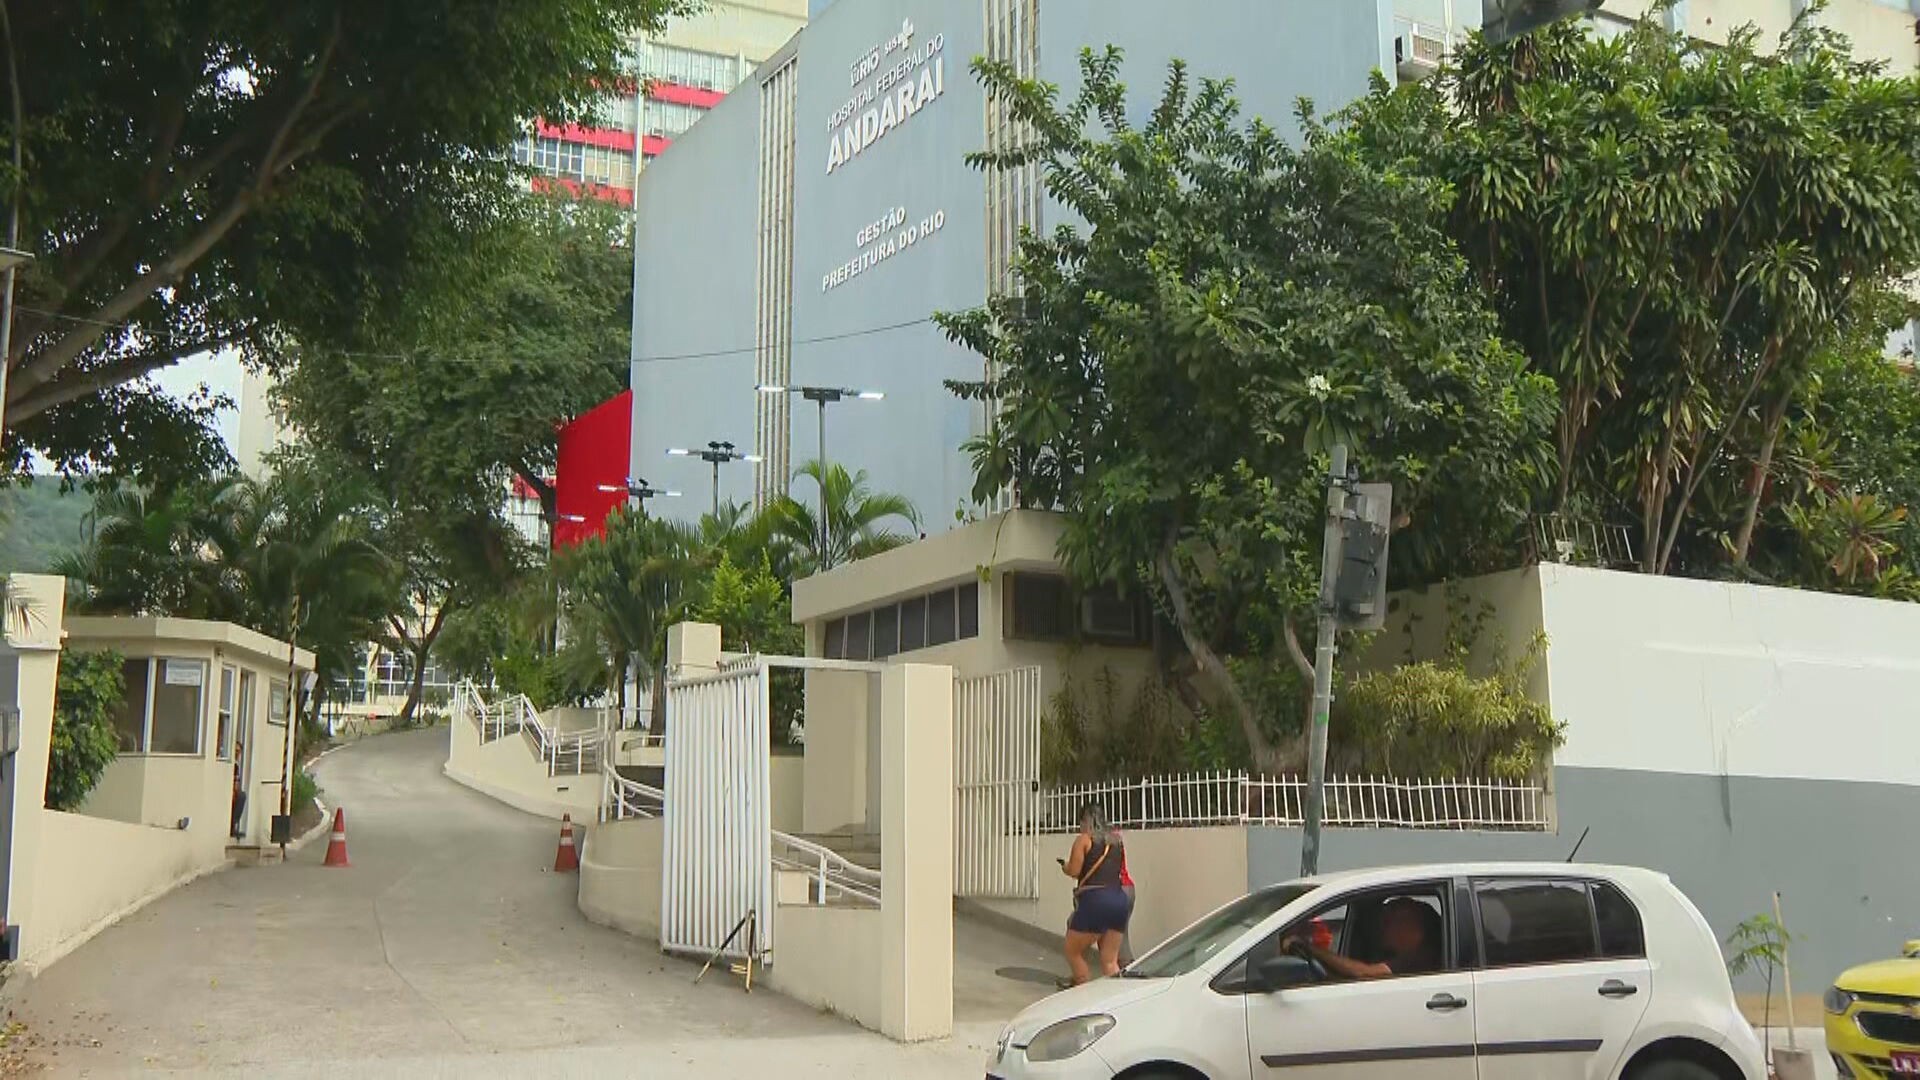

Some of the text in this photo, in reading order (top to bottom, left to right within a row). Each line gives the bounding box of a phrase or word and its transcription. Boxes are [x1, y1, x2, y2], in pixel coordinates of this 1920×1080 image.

[827, 87, 874, 132] HOSPITAL
[876, 49, 924, 96] FEDERAL
[926, 33, 944, 59] DO
[822, 209, 945, 293] PREFEITURA DO RIO
[856, 206, 905, 248] GESTÃO
